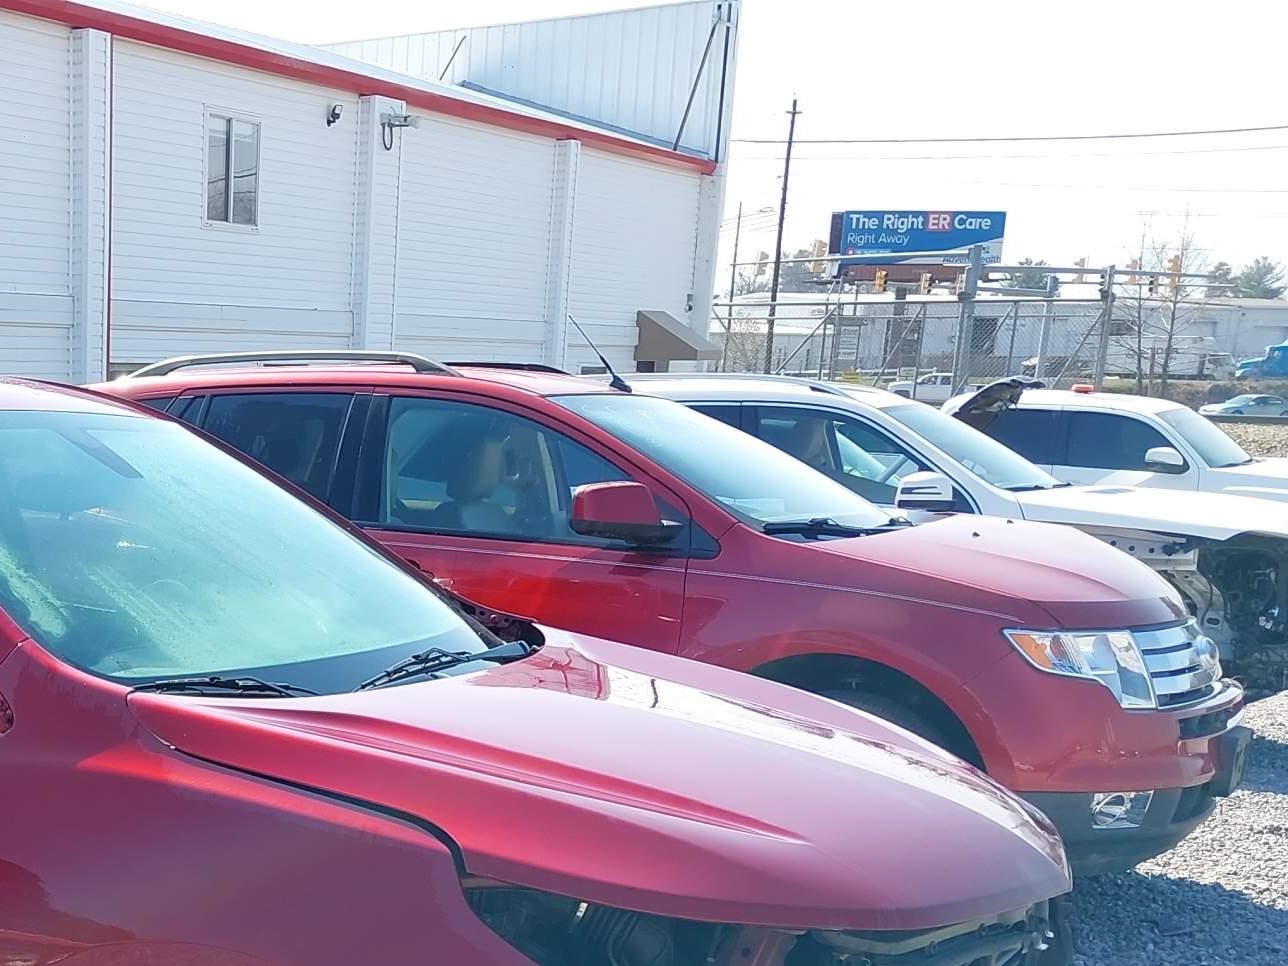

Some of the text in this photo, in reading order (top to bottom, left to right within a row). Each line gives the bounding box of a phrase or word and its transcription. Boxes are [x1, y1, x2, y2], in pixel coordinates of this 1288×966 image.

[849, 214, 992, 233] The Right ER Care
[847, 233, 910, 246] Right Away
